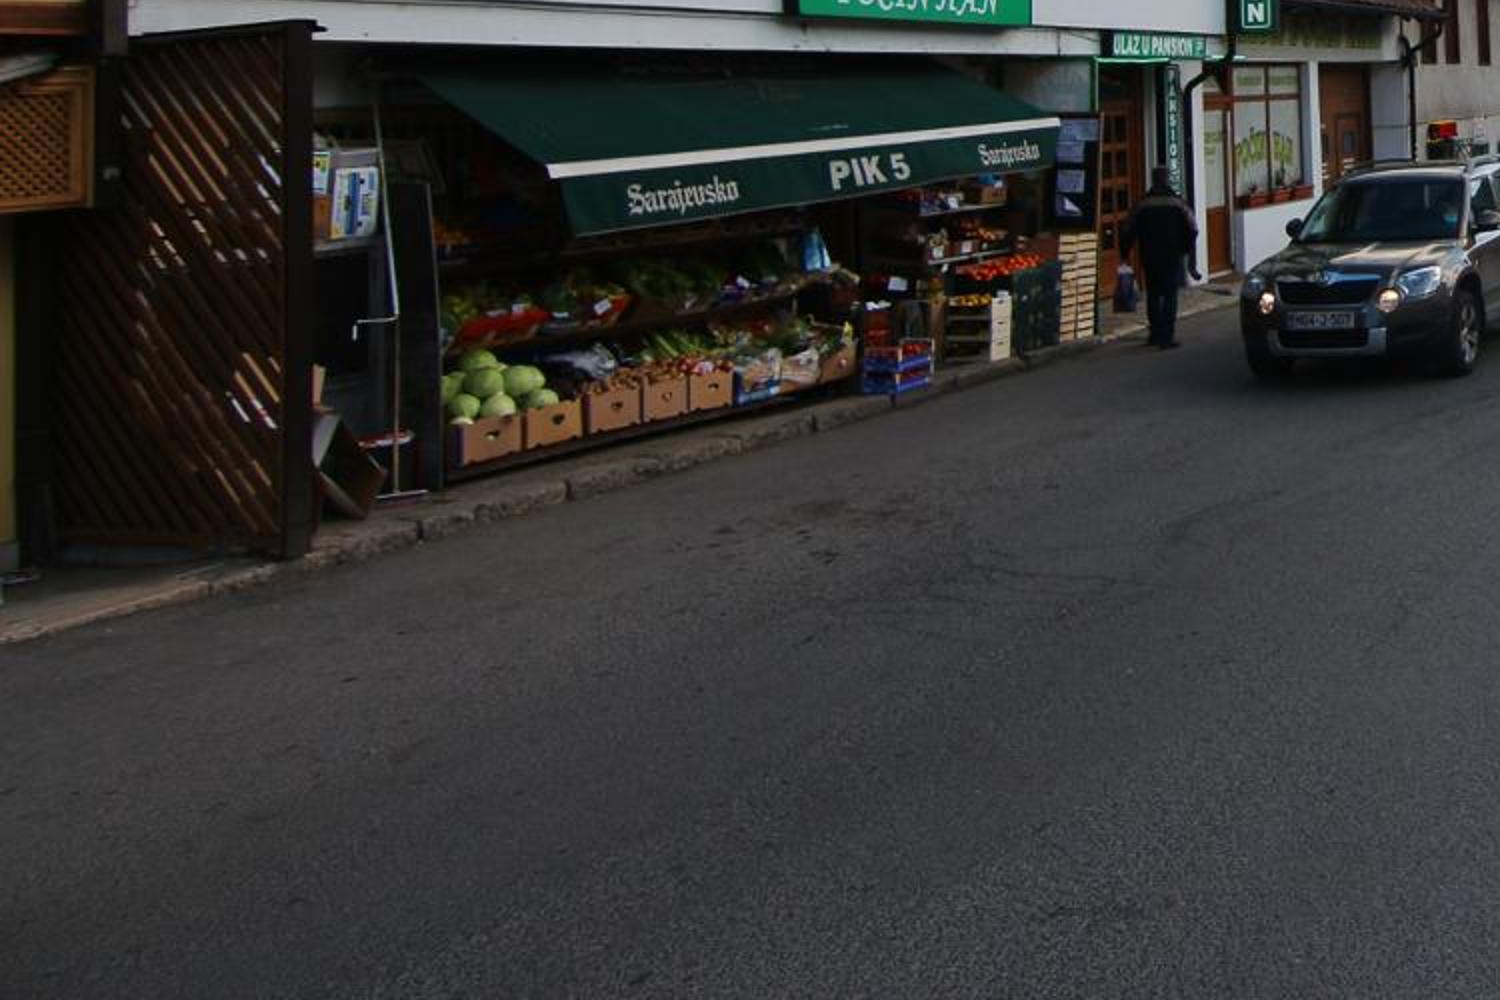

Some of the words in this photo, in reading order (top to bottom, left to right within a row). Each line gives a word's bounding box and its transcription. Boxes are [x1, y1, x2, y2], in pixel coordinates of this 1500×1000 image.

[1113, 34, 1140, 56] ULAZ
[1152, 35, 1192, 56] PANSION
[829, 156, 887, 190] PIK
[891, 153, 911, 181] 5
[626, 174, 740, 217] Sarajevsko
